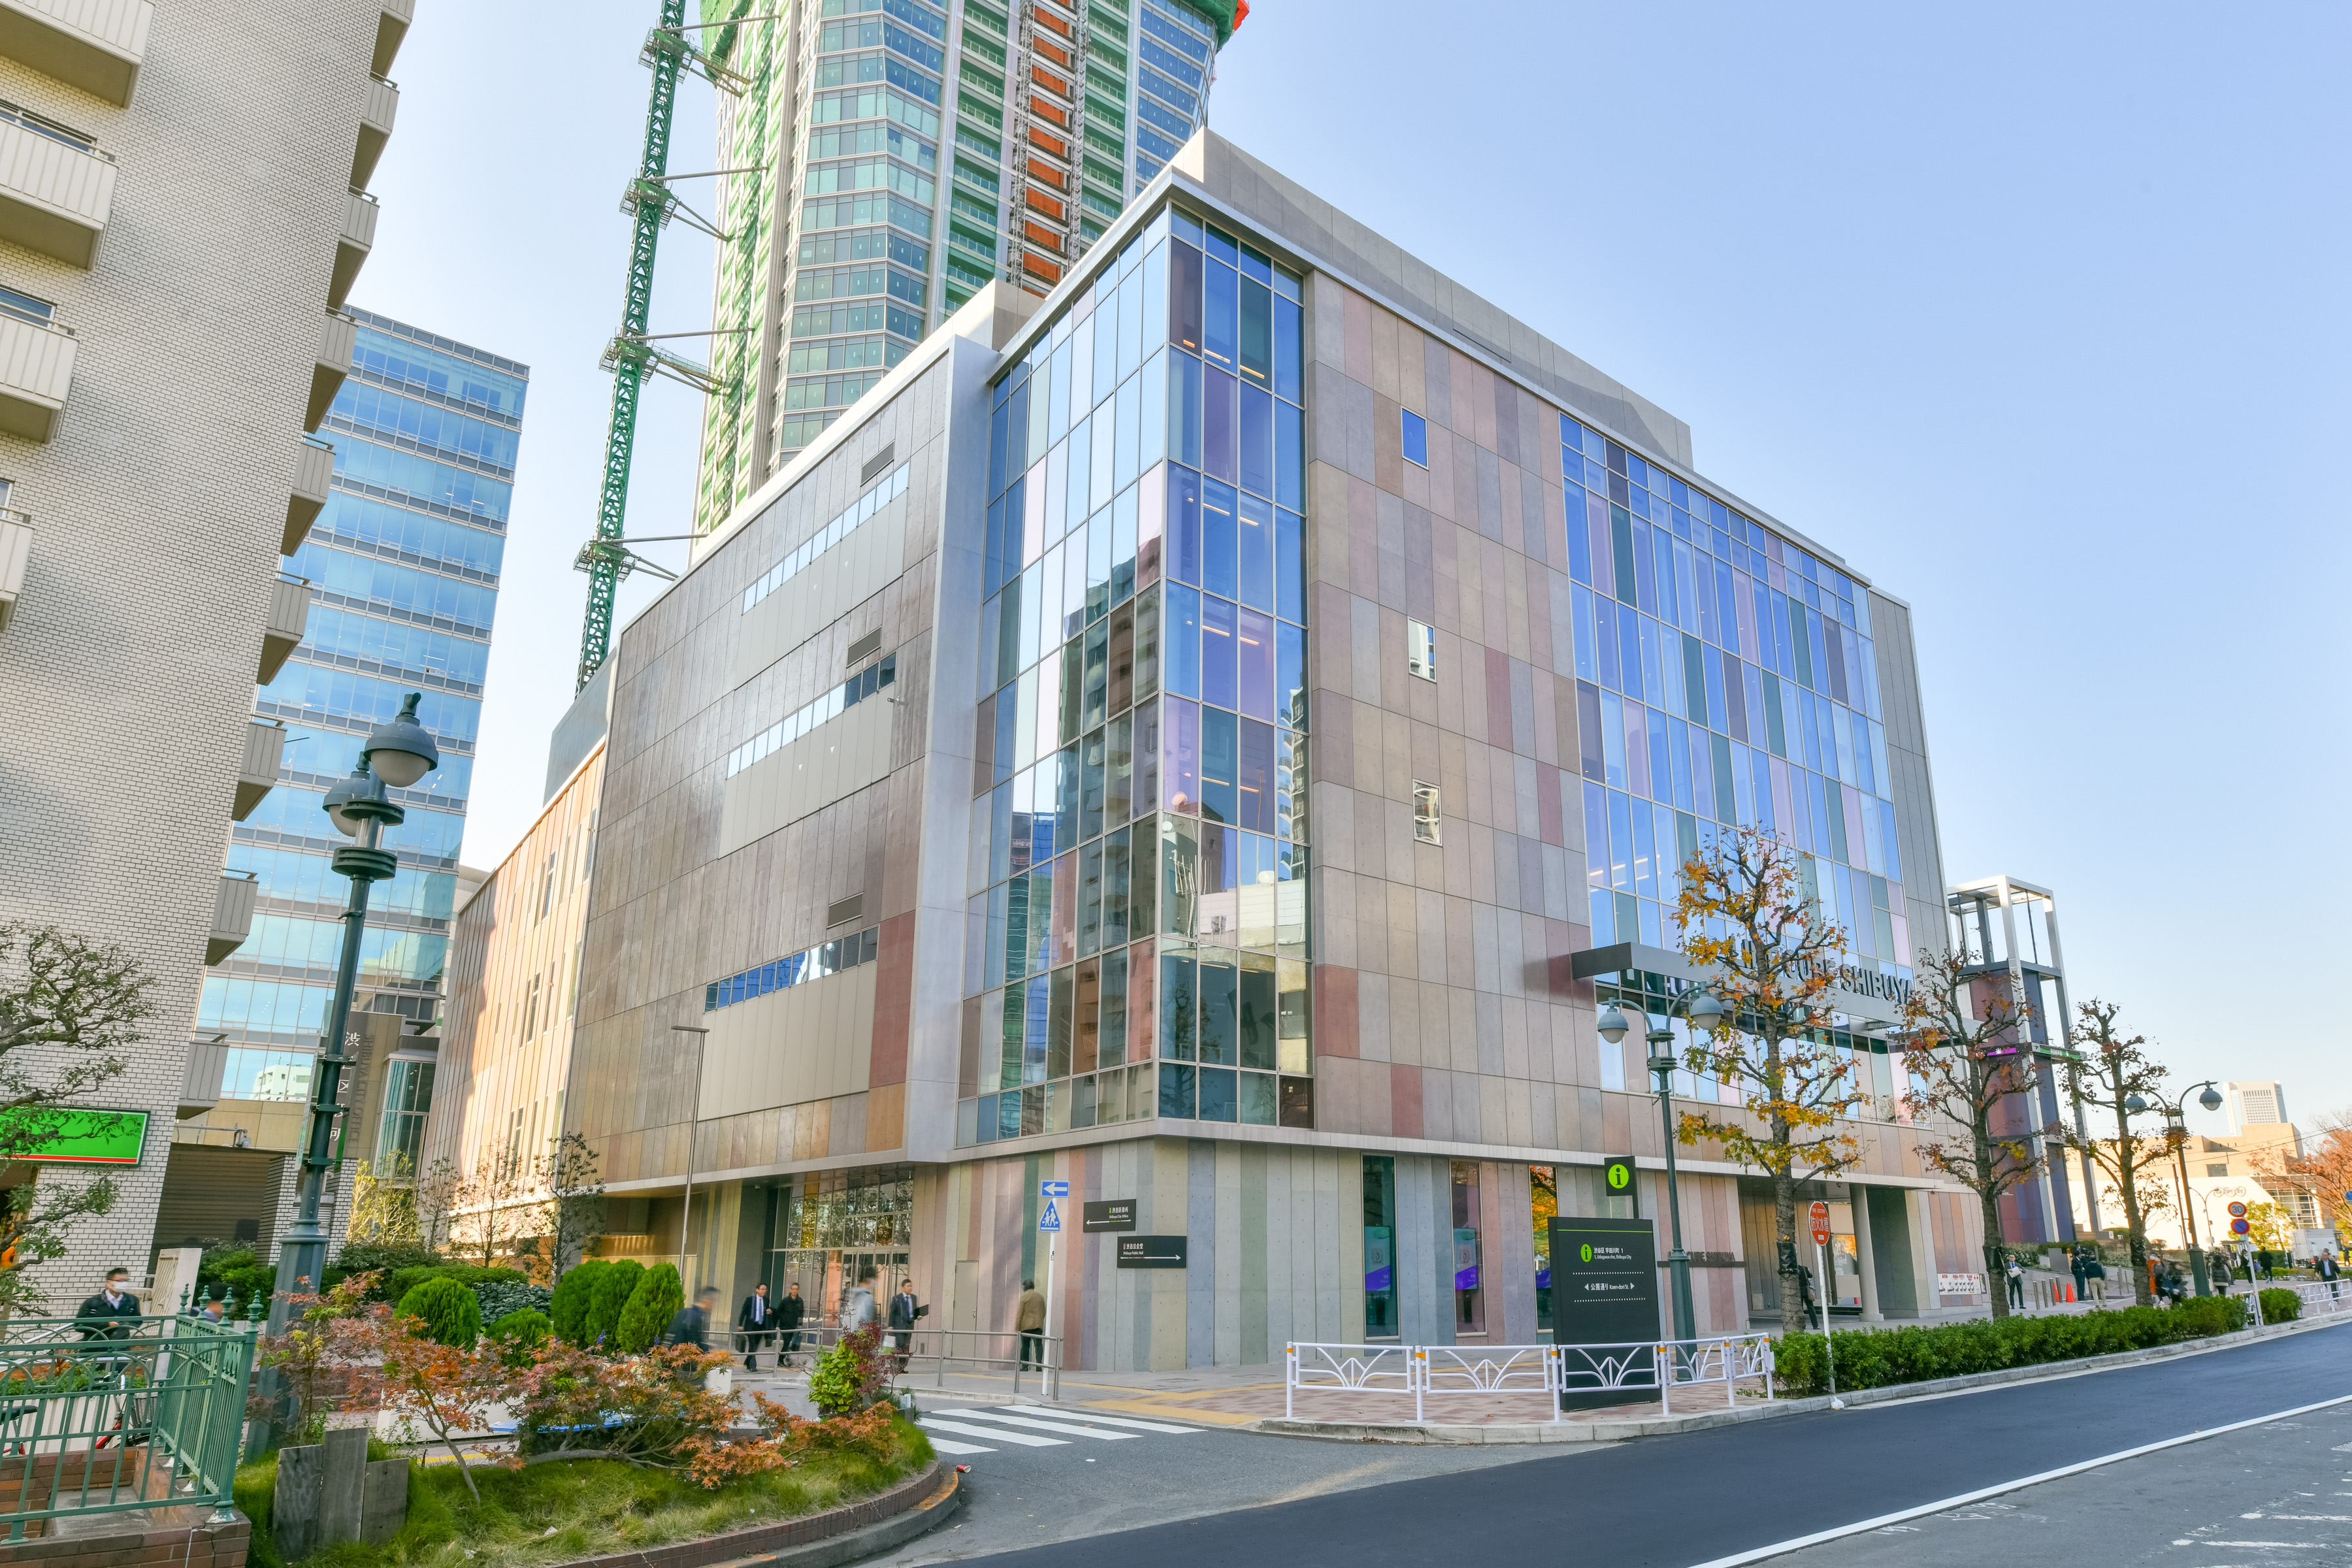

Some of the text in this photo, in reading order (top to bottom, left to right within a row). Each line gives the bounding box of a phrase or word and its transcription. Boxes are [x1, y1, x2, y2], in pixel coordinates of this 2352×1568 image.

[1840, 964, 1915, 1004] SHIBUYA
[348, 1034, 374, 1143] SHIBUYA CITY OFFICE
[1810, 1216, 1829, 1232] 防火水槽
